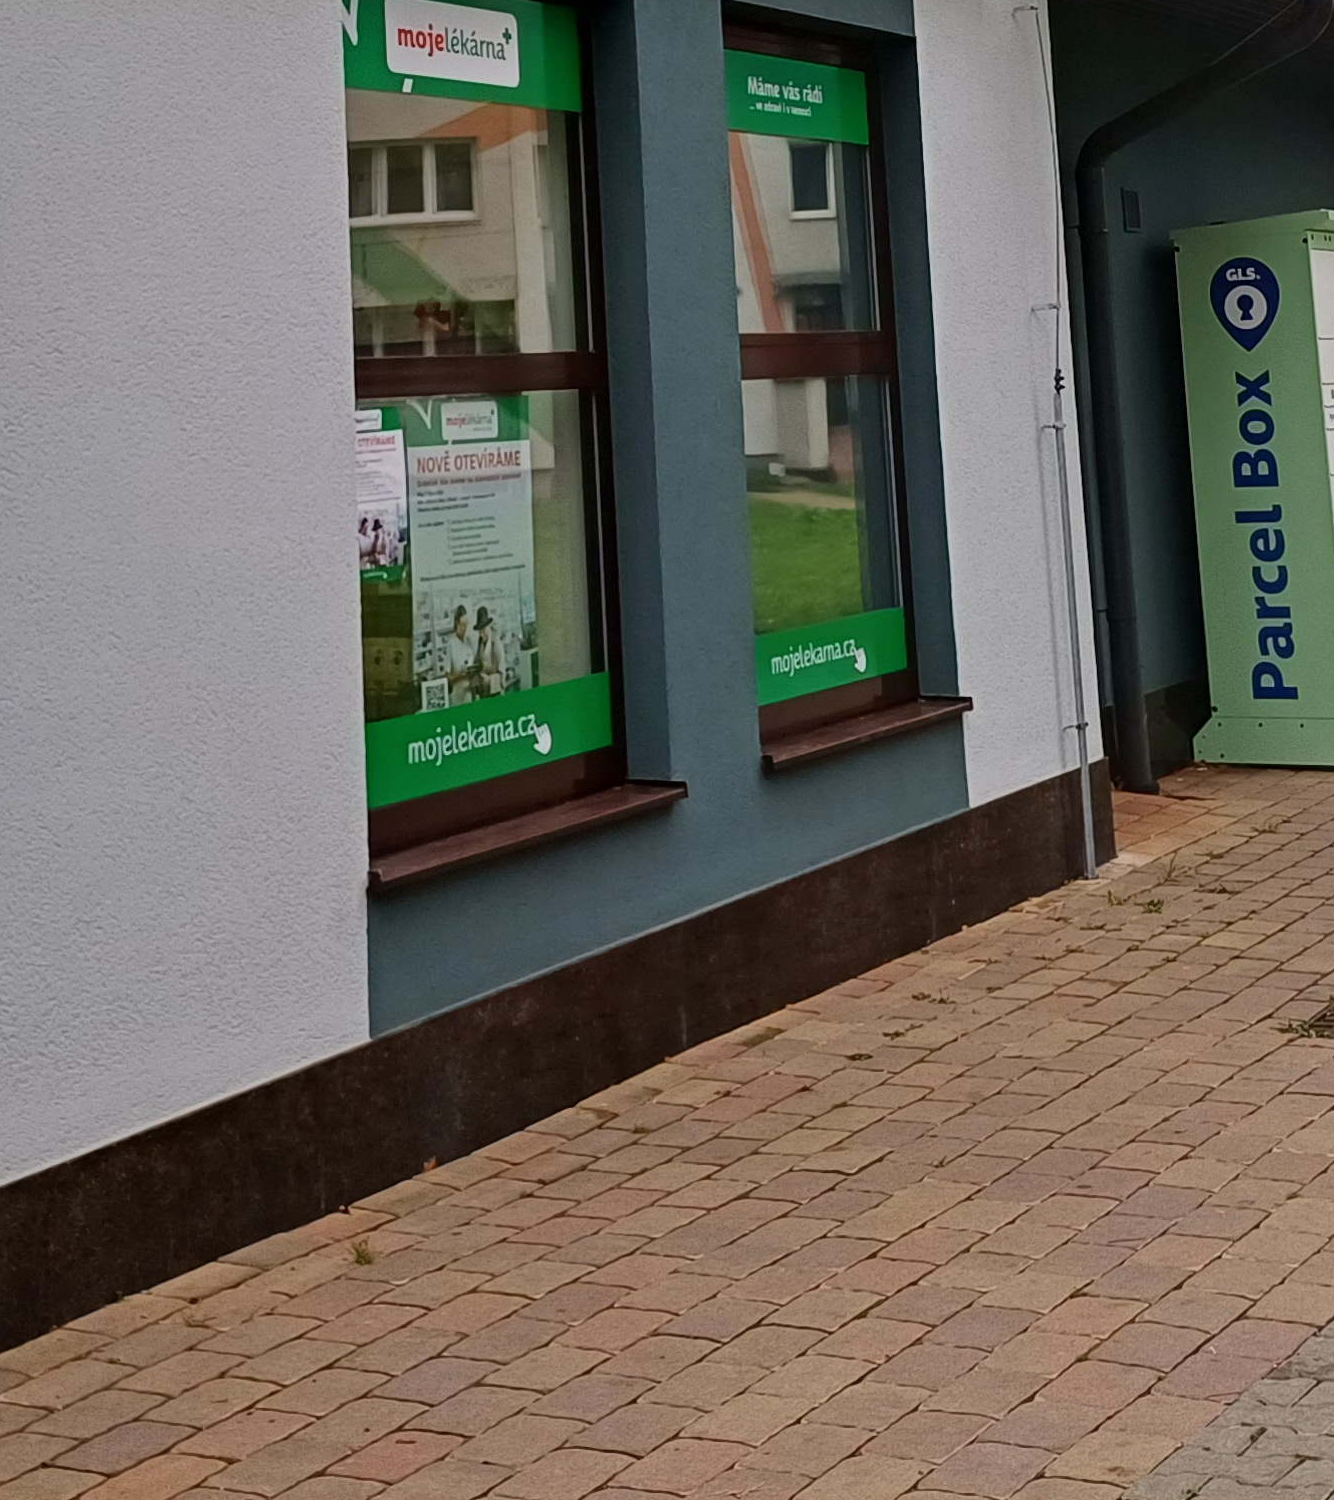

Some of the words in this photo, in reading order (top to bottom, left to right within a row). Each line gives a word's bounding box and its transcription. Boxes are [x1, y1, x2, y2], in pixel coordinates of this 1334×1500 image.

[397, 23, 507, 61] mojelékárna
[748, 75, 780, 98] Máme
[782, 80, 801, 101] vás
[803, 84, 823, 104] rádi
[1232, 370, 1280, 488] Box
[417, 450, 451, 474] NOVĚ
[454, 447, 522, 472] OTEVÍRÁME
[1234, 503, 1300, 701] Parcel
[408, 713, 537, 766] mojelekarna.cz
